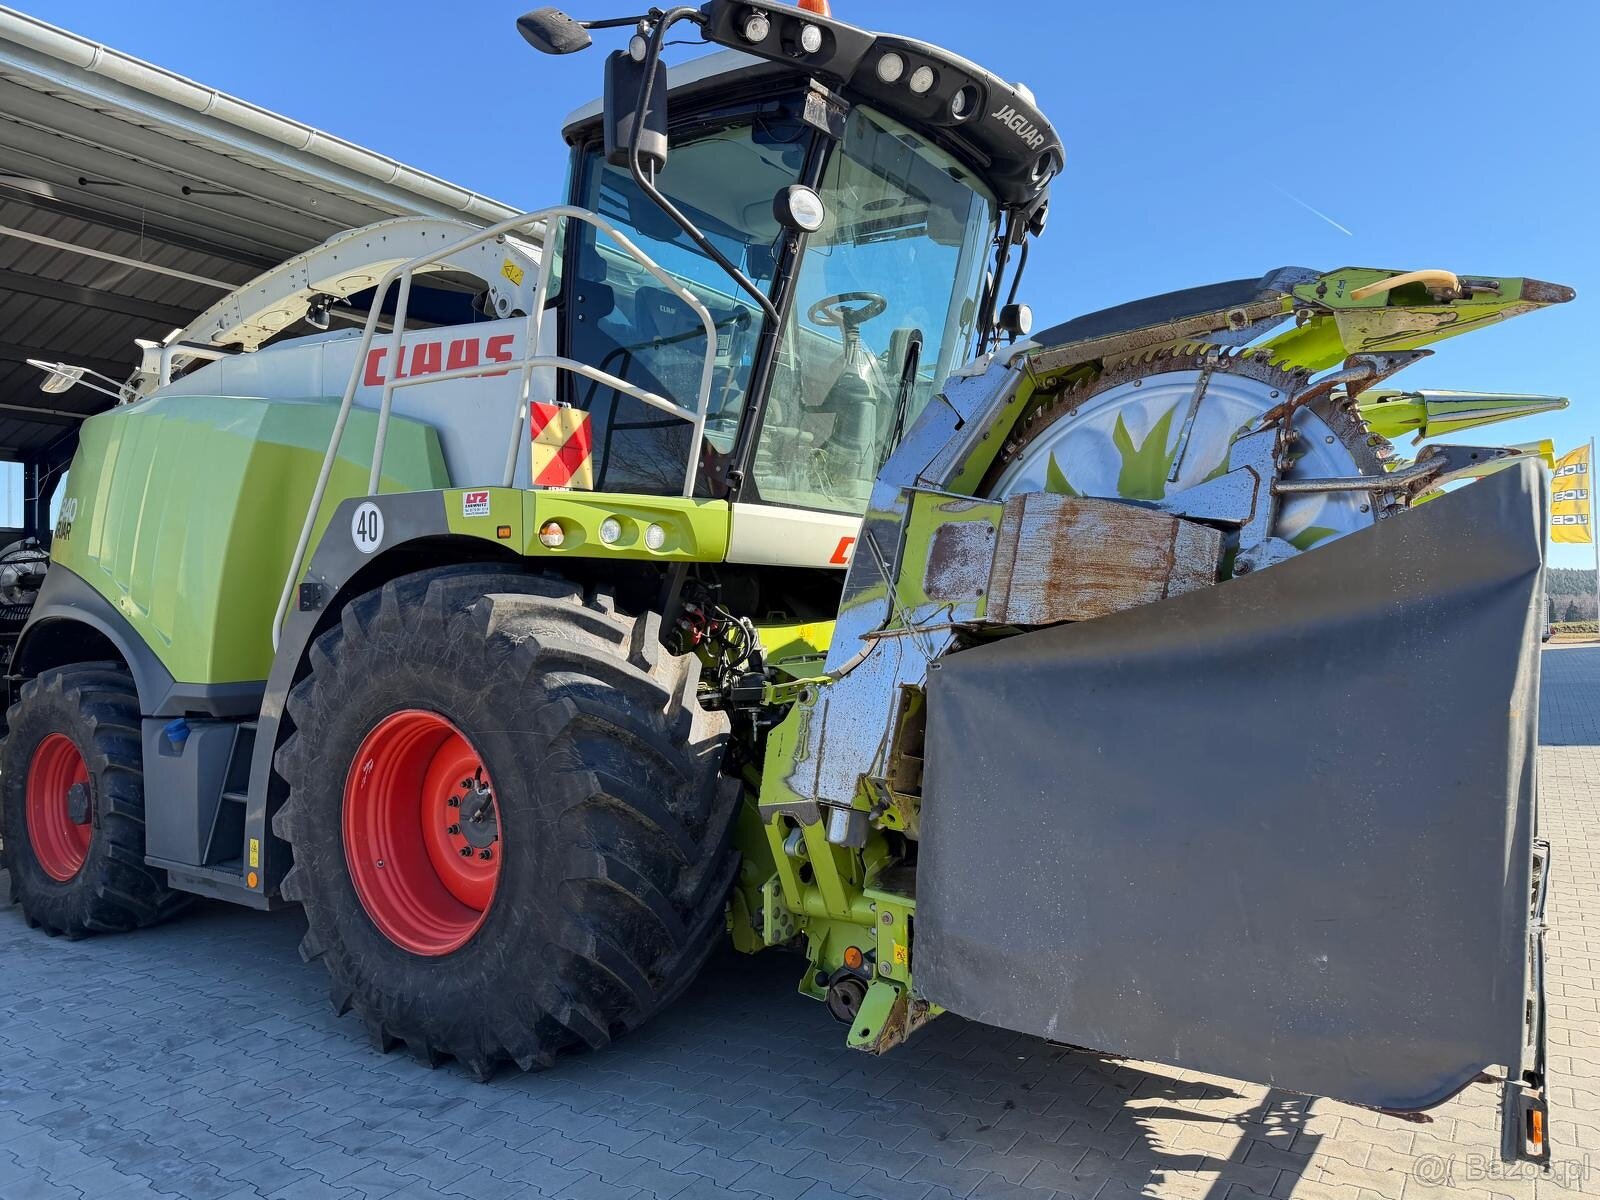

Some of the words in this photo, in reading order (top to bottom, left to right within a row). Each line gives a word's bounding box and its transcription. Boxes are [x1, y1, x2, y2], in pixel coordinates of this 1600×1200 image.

[991, 104, 1045, 150] JAGUAR
[363, 334, 515, 386] CLAAS
[466, 492, 488, 504] LTZ
[357, 510, 378, 543] 40
[829, 536, 856, 565] C
